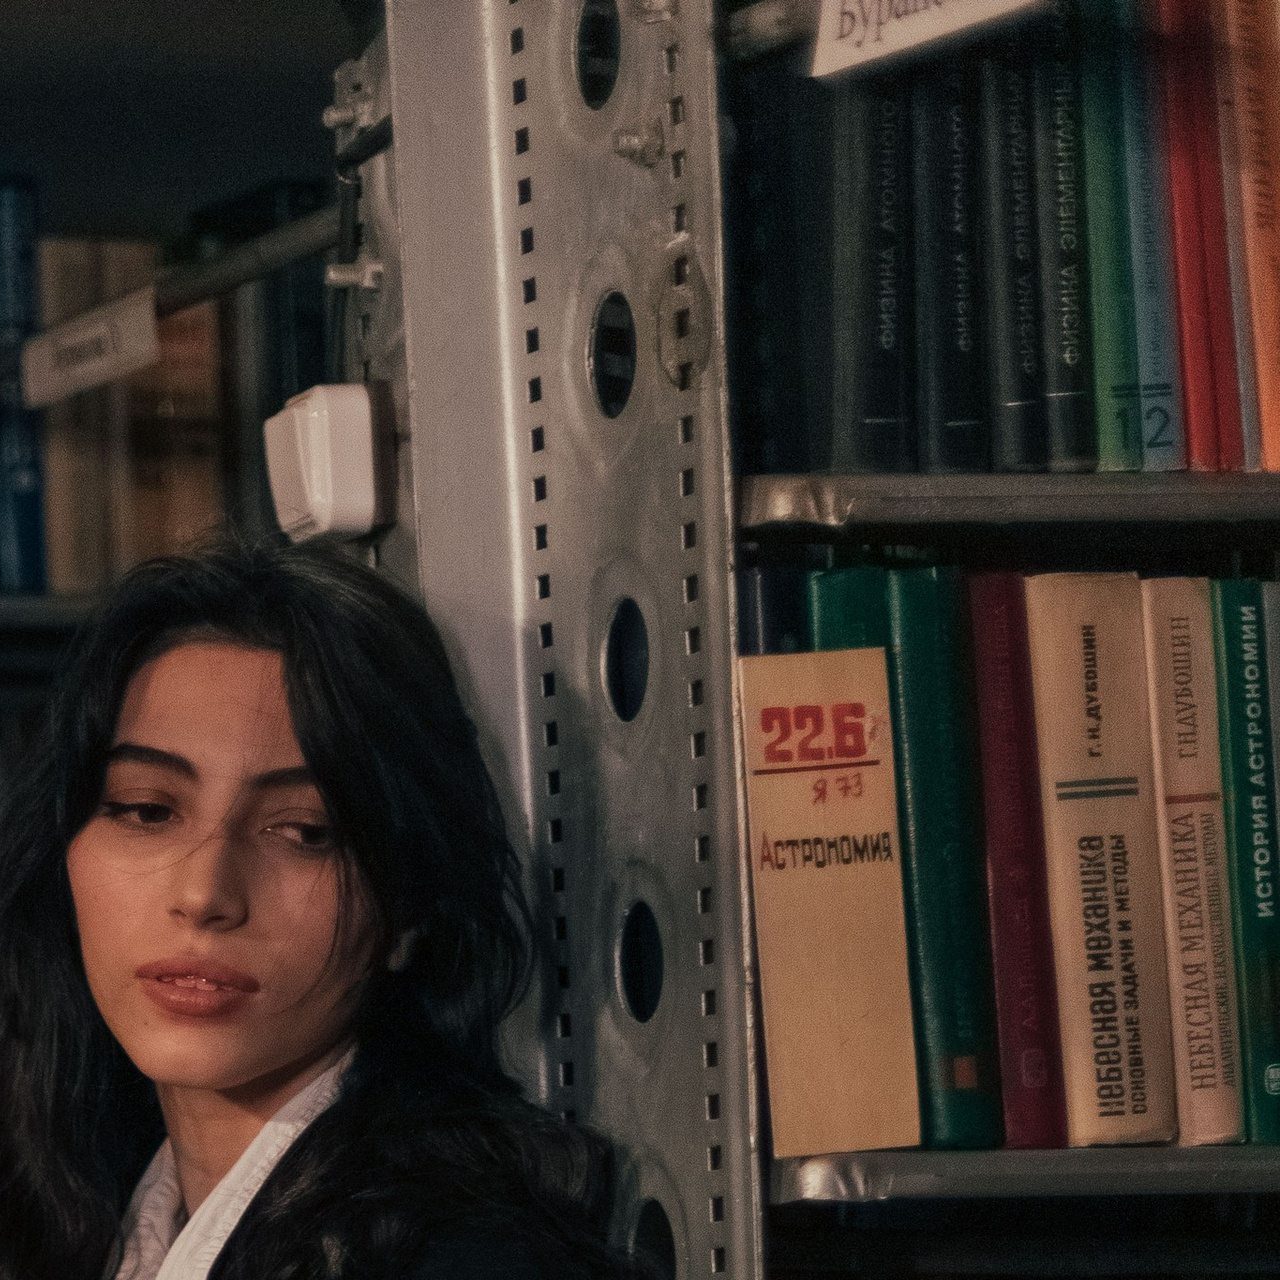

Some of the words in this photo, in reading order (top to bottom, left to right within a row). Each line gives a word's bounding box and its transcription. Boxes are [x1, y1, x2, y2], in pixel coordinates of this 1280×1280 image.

[878, 99, 897, 231] АТОМНОГО
[878, 248, 897, 350] ФИЗИКА
[1017, 273, 1037, 374] ФИЗИКА
[1058, 262, 1081, 366] ФИЗИКА
[1116, 408, 1129, 449] 1
[1146, 406, 1173, 448] 2
[761, 703, 867, 763] 22.6
[1240, 604, 1267, 788] АСТРОНОМИИ
[1109, 834, 1131, 912] МЕТОДЫ
[1169, 812, 1206, 956] МЕХАНИКА
[1200, 812, 1222, 867] МЕТОДЫ
[1251, 795, 1277, 918] ИСТОРИЯ
[1117, 919, 1132, 932] И
[1118, 938, 1140, 1010] ЗАДАЧИ
[1122, 1015, 1148, 1115] ОСНОВНЫЕ
[1181, 960, 1218, 1092] НЕБЕСНАЯ
